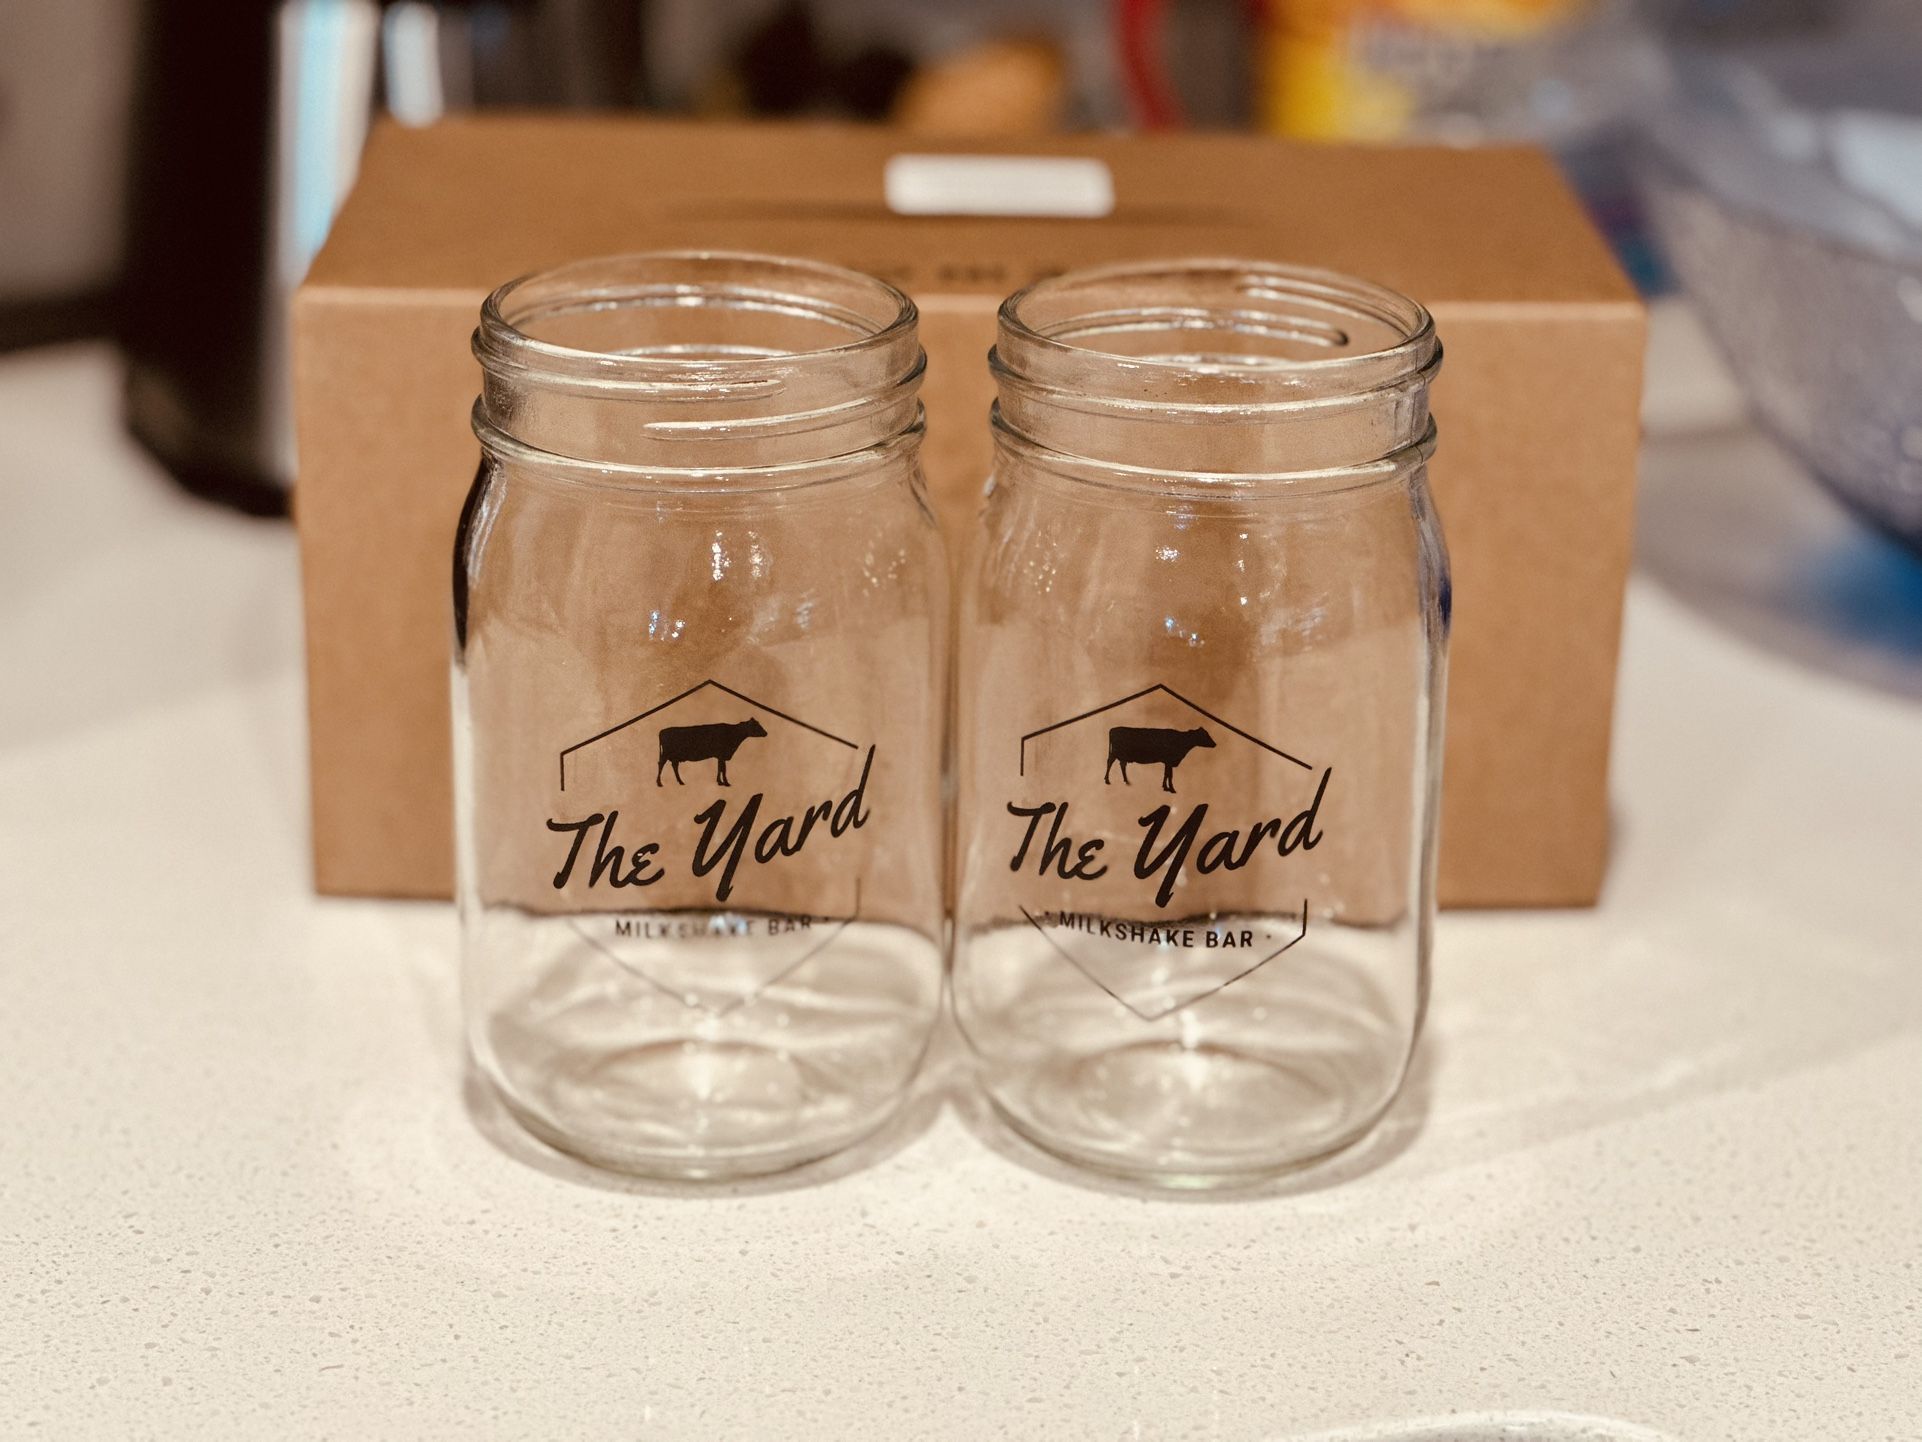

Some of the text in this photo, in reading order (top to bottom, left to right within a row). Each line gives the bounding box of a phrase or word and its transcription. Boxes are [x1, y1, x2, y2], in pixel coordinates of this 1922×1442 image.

[546, 743, 876, 902] The Yard
[1006, 767, 1332, 908] The Yard
[767, 915, 813, 936] BAR
[1059, 911, 1254, 948] MILKSHAKE BAR
